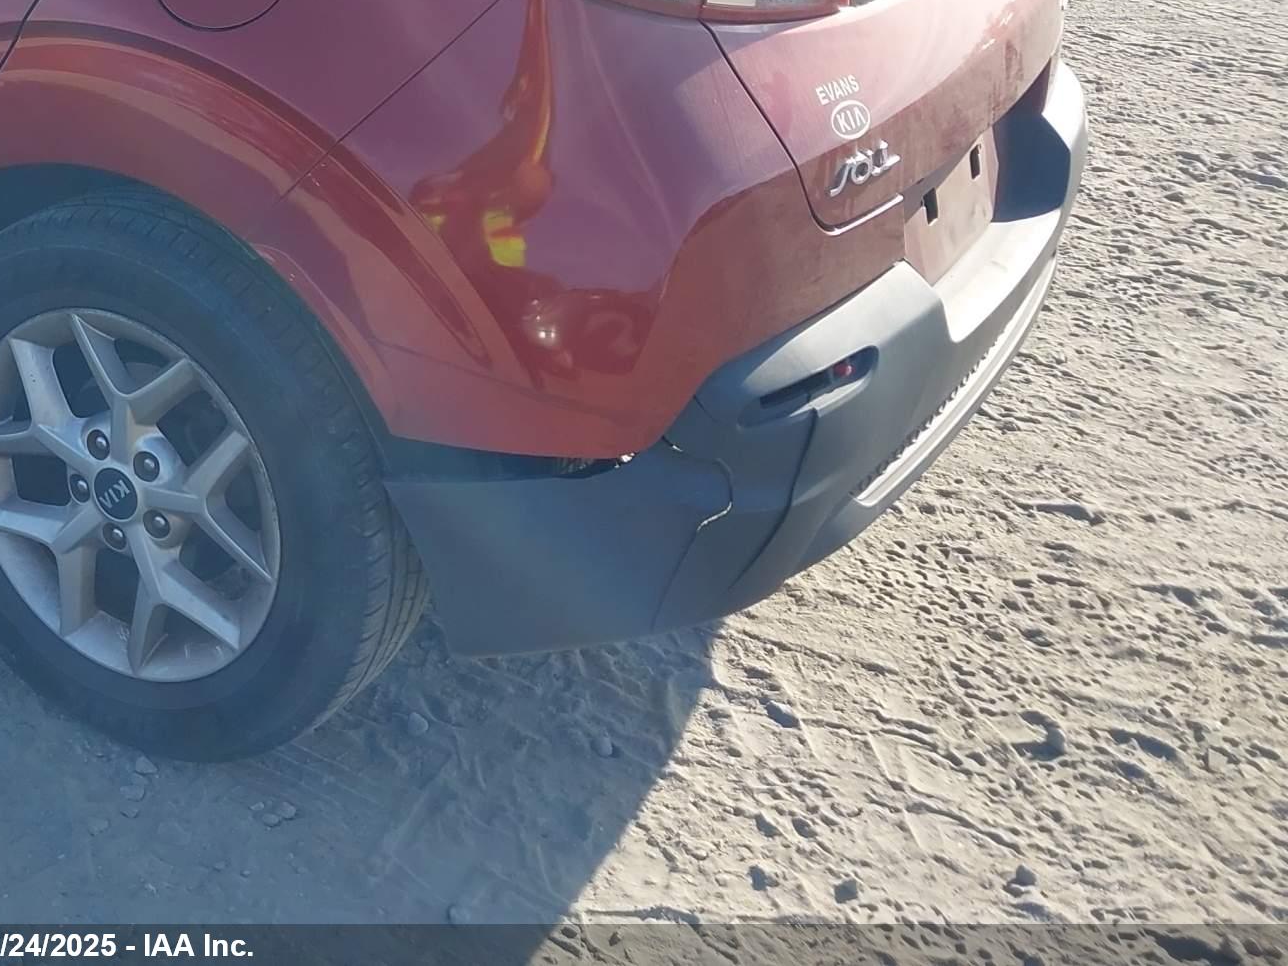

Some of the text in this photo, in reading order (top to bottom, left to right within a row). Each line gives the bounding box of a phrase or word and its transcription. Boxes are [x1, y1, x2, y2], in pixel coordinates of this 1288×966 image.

[815, 74, 860, 106] EVANS
[836, 106, 866, 133] KIA
[99, 479, 130, 509] KIA
